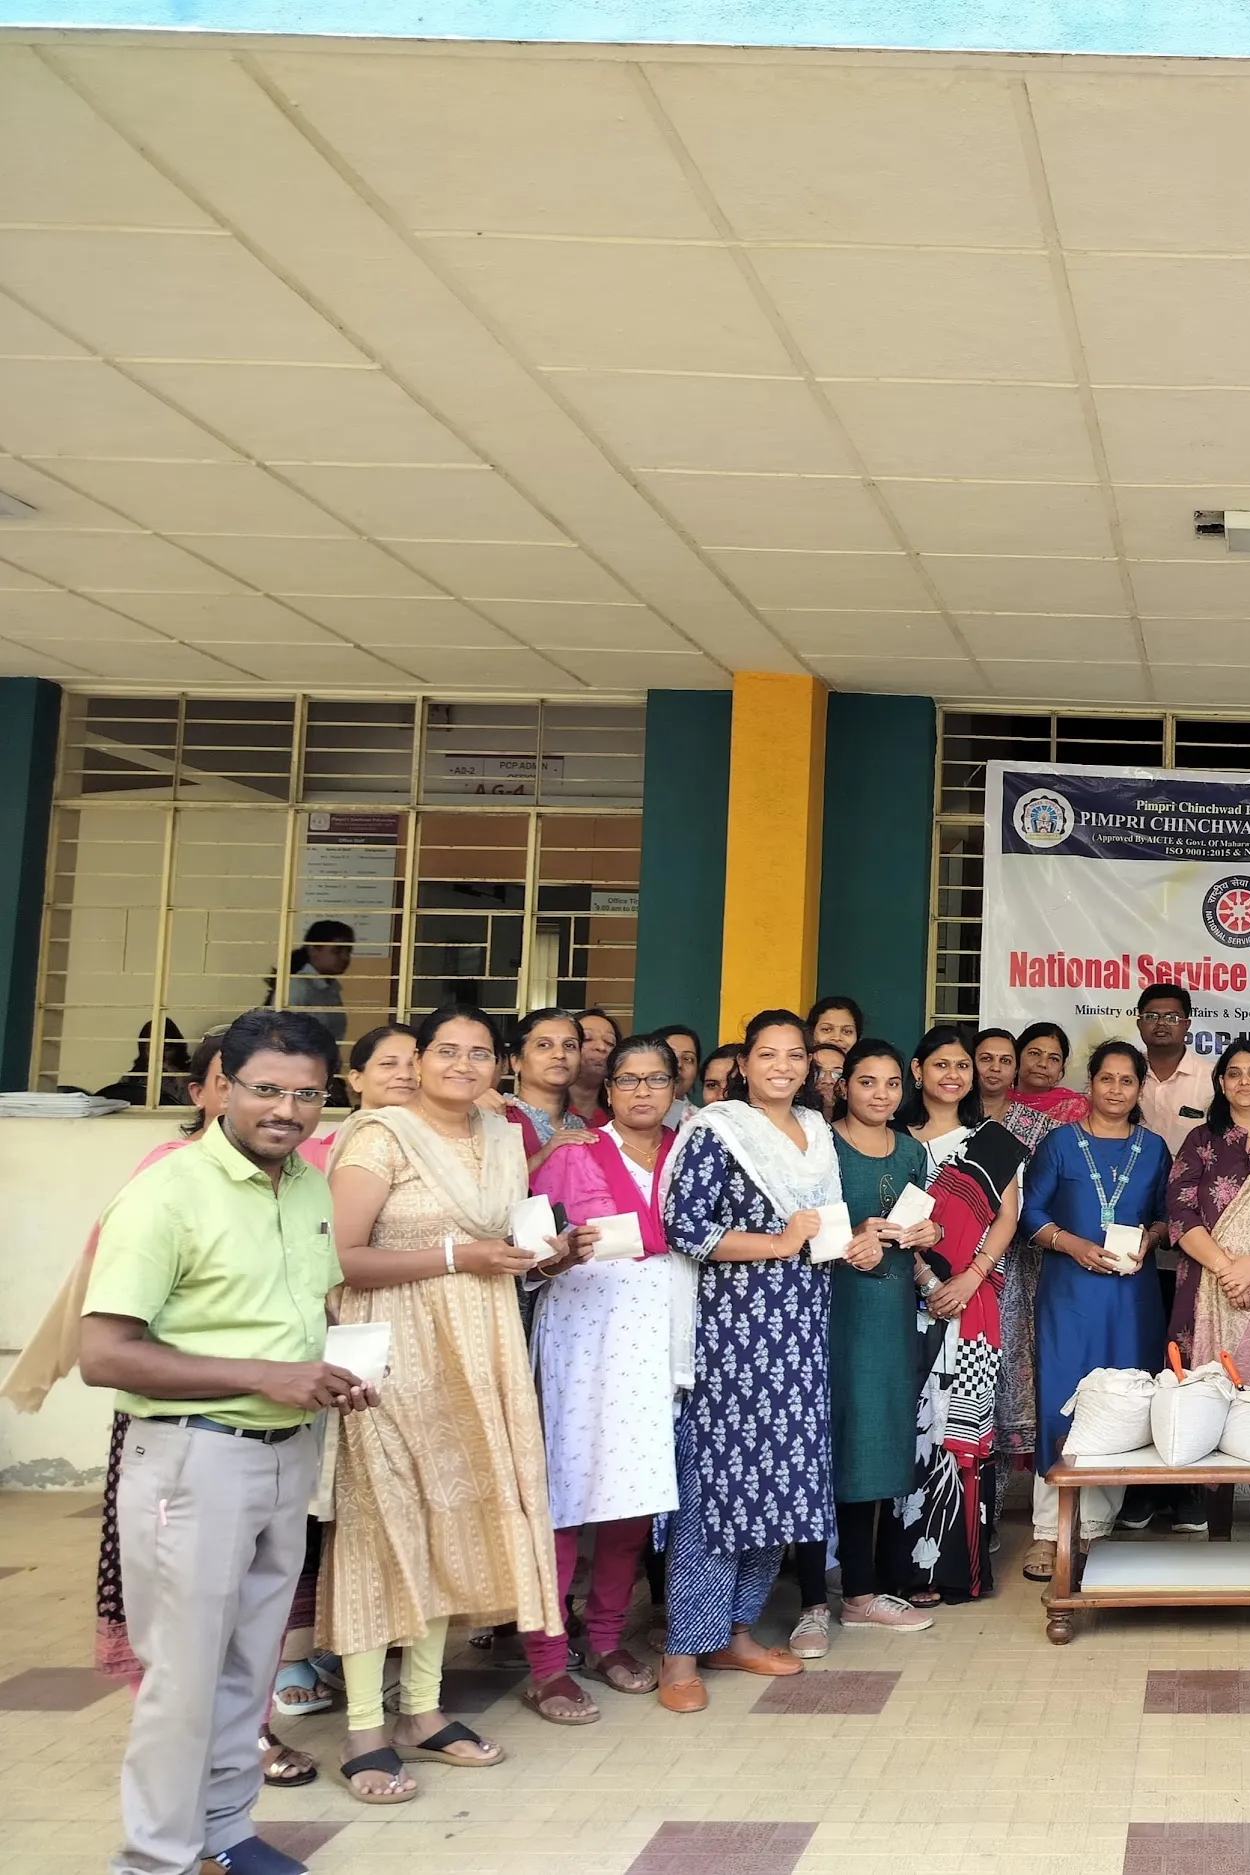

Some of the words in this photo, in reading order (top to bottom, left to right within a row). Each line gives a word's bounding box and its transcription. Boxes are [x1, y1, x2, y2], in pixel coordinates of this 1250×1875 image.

[500, 761, 517, 769] PCP
[519, 761, 548, 770] ADMN
[1136, 800, 1175, 813] Pimpri
[1178, 801, 1242, 815] Chinchwad
[1079, 811, 1146, 829] PIMPRI
[1146, 836, 1174, 845] AICTE
[1176, 837, 1184, 845] &
[1185, 838, 1207, 847] Govt.
[1208, 839, 1218, 847] Of
[1165, 846, 1183, 855] ISO
[1185, 847, 1231, 857] 9001:2015
[1232, 848, 1242, 856] &
[1230, 877, 1249, 887] सेवा
[1205, 910, 1226, 941] NATIONAL
[1009, 951, 1130, 990] National
[1137, 953, 1248, 992] Service
[1074, 1004, 1122, 1018] Ministry
[1126, 1007, 1139, 1016] of
[1190, 1007, 1218, 1018] ffairs
[1222, 1008, 1230, 1018] &
